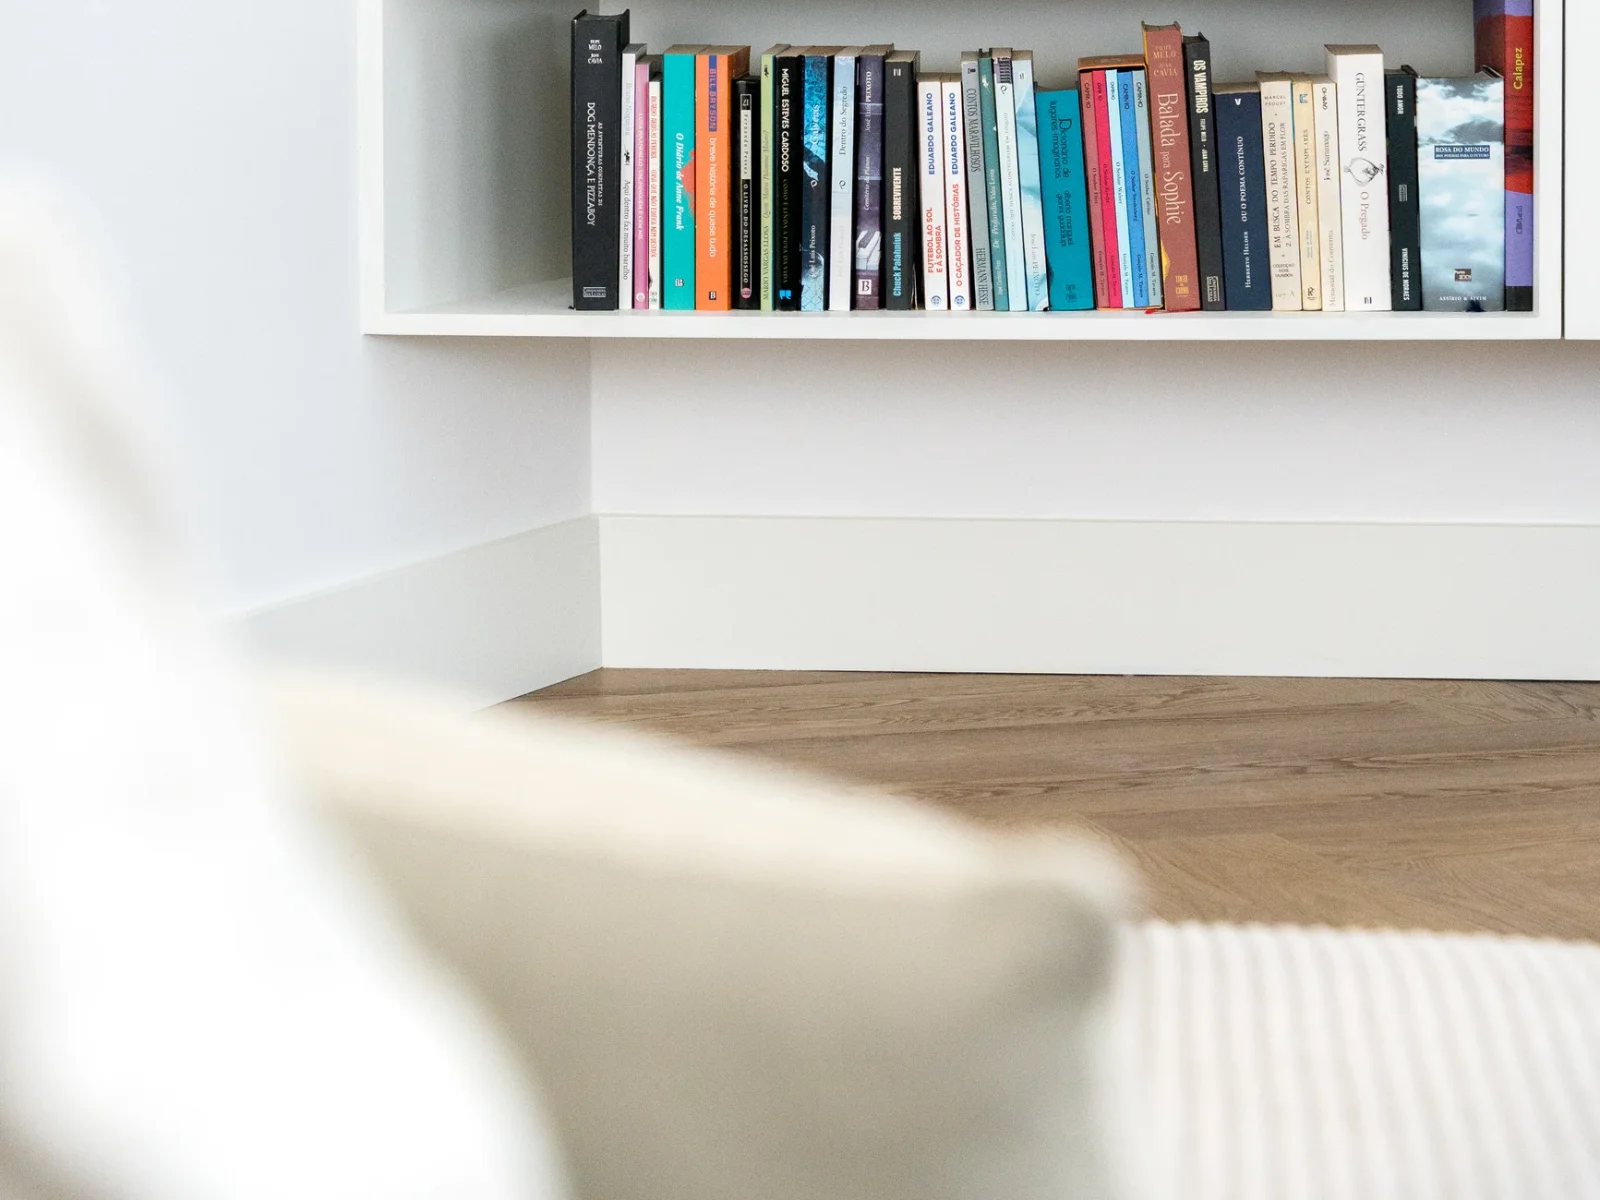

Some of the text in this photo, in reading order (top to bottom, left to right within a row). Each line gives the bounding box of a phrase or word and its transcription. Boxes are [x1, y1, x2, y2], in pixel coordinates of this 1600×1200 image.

[1153, 50, 1176, 59] MELO
[1513, 48, 1525, 90] Calapez
[1153, 68, 1178, 77] CAVIA
[1193, 60, 1209, 114] OS VAMPIROS
[588, 102, 596, 122] DOG
[709, 68, 717, 130] BILL BRYSON
[926, 92, 934, 133] GALEANO
[966, 88, 977, 116] CONTOS
[782, 68, 790, 172] MIGUEL ESTEVES CARDOSO
[839, 86, 849, 155] Dentro do Segredo
[1048, 100, 1058, 132] lugares
[949, 92, 958, 175] EDUARDO GALEANO
[968, 118, 981, 172] MARAVILHOSOS
[1280, 141, 1286, 150] EM
[1356, 118, 1367, 152] GRASS
[586, 124, 596, 176] MENDONÇA
[676, 142, 684, 169] Diário
[1158, 92, 1186, 225] Balada para Sophie
[1236, 136, 1246, 176] CONTÍNUO
[1322, 130, 1331, 181] José Saramago
[676, 170, 684, 181] de
[864, 176, 870, 184] de
[988, 169, 996, 184] Lenta
[1062, 167, 1072, 178] de
[1268, 122, 1281, 248] EM BUSCA DO TEMPO PERDIDO
[1281, 151, 1289, 189] RAPARIGAS
[622, 180, 631, 196] Aqui
[676, 182, 684, 204] Anne
[707, 137, 718, 258] breve história de quase tudo
[892, 167, 902, 220] SOBREVIVENTE
[1239, 176, 1247, 201] POEMA
[587, 186, 596, 226] PIZZABOY
[624, 197, 632, 220] dentro
[676, 206, 684, 230] Frank
[952, 184, 960, 226] HISTÓRIAS
[1064, 190, 1074, 246] alberto manguel
[1241, 210, 1247, 222] OU
[1359, 191, 1370, 240] O Pregado
[624, 220, 632, 232] faz
[744, 216, 749, 227] DO
[926, 224, 933, 236] AO
[954, 227, 960, 238] DE
[934, 225, 942, 258] SOMBRA
[992, 239, 1000, 249] De
[623, 254, 631, 280] barulho
[783, 256, 788, 264] DA
[892, 232, 902, 296] Chuck Palahniuk
[954, 240, 964, 278] CAÇADOR
[1328, 264, 1334, 273] do
[976, 248, 988, 305] HERMANN HESSE
